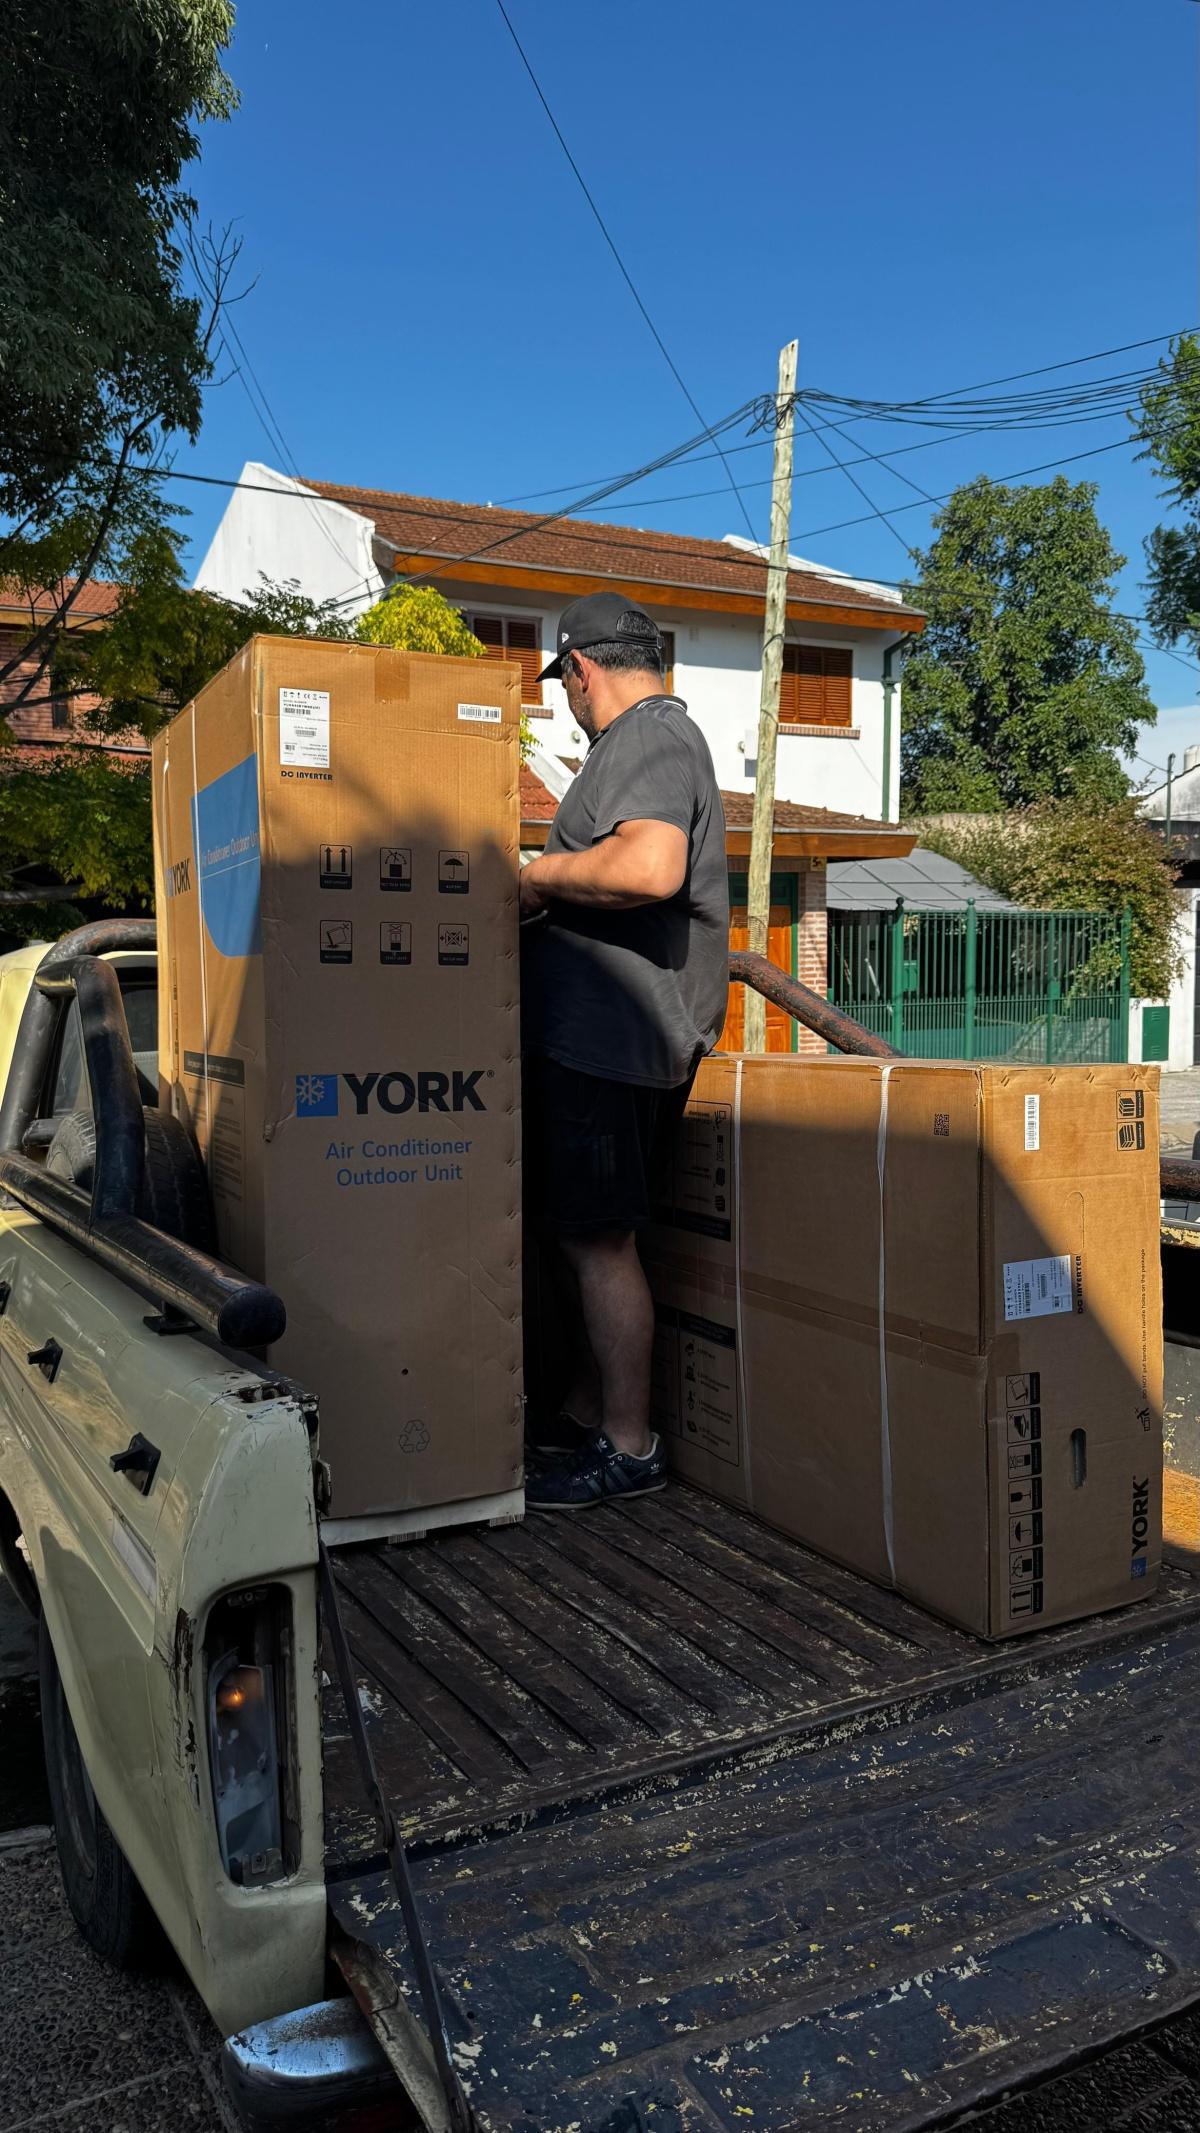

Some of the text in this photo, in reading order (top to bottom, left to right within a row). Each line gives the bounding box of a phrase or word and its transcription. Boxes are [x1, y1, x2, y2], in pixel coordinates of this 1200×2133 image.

[281, 770, 333, 781] DC INVERTER
[172, 858, 191, 896] YORK
[325, 1138, 473, 1160] Air Conditioner
[336, 1164, 463, 1187] Outdoor Unit
[1075, 1255, 1084, 1314] DC INVERTER
[1131, 1478, 1149, 1556] YORK
